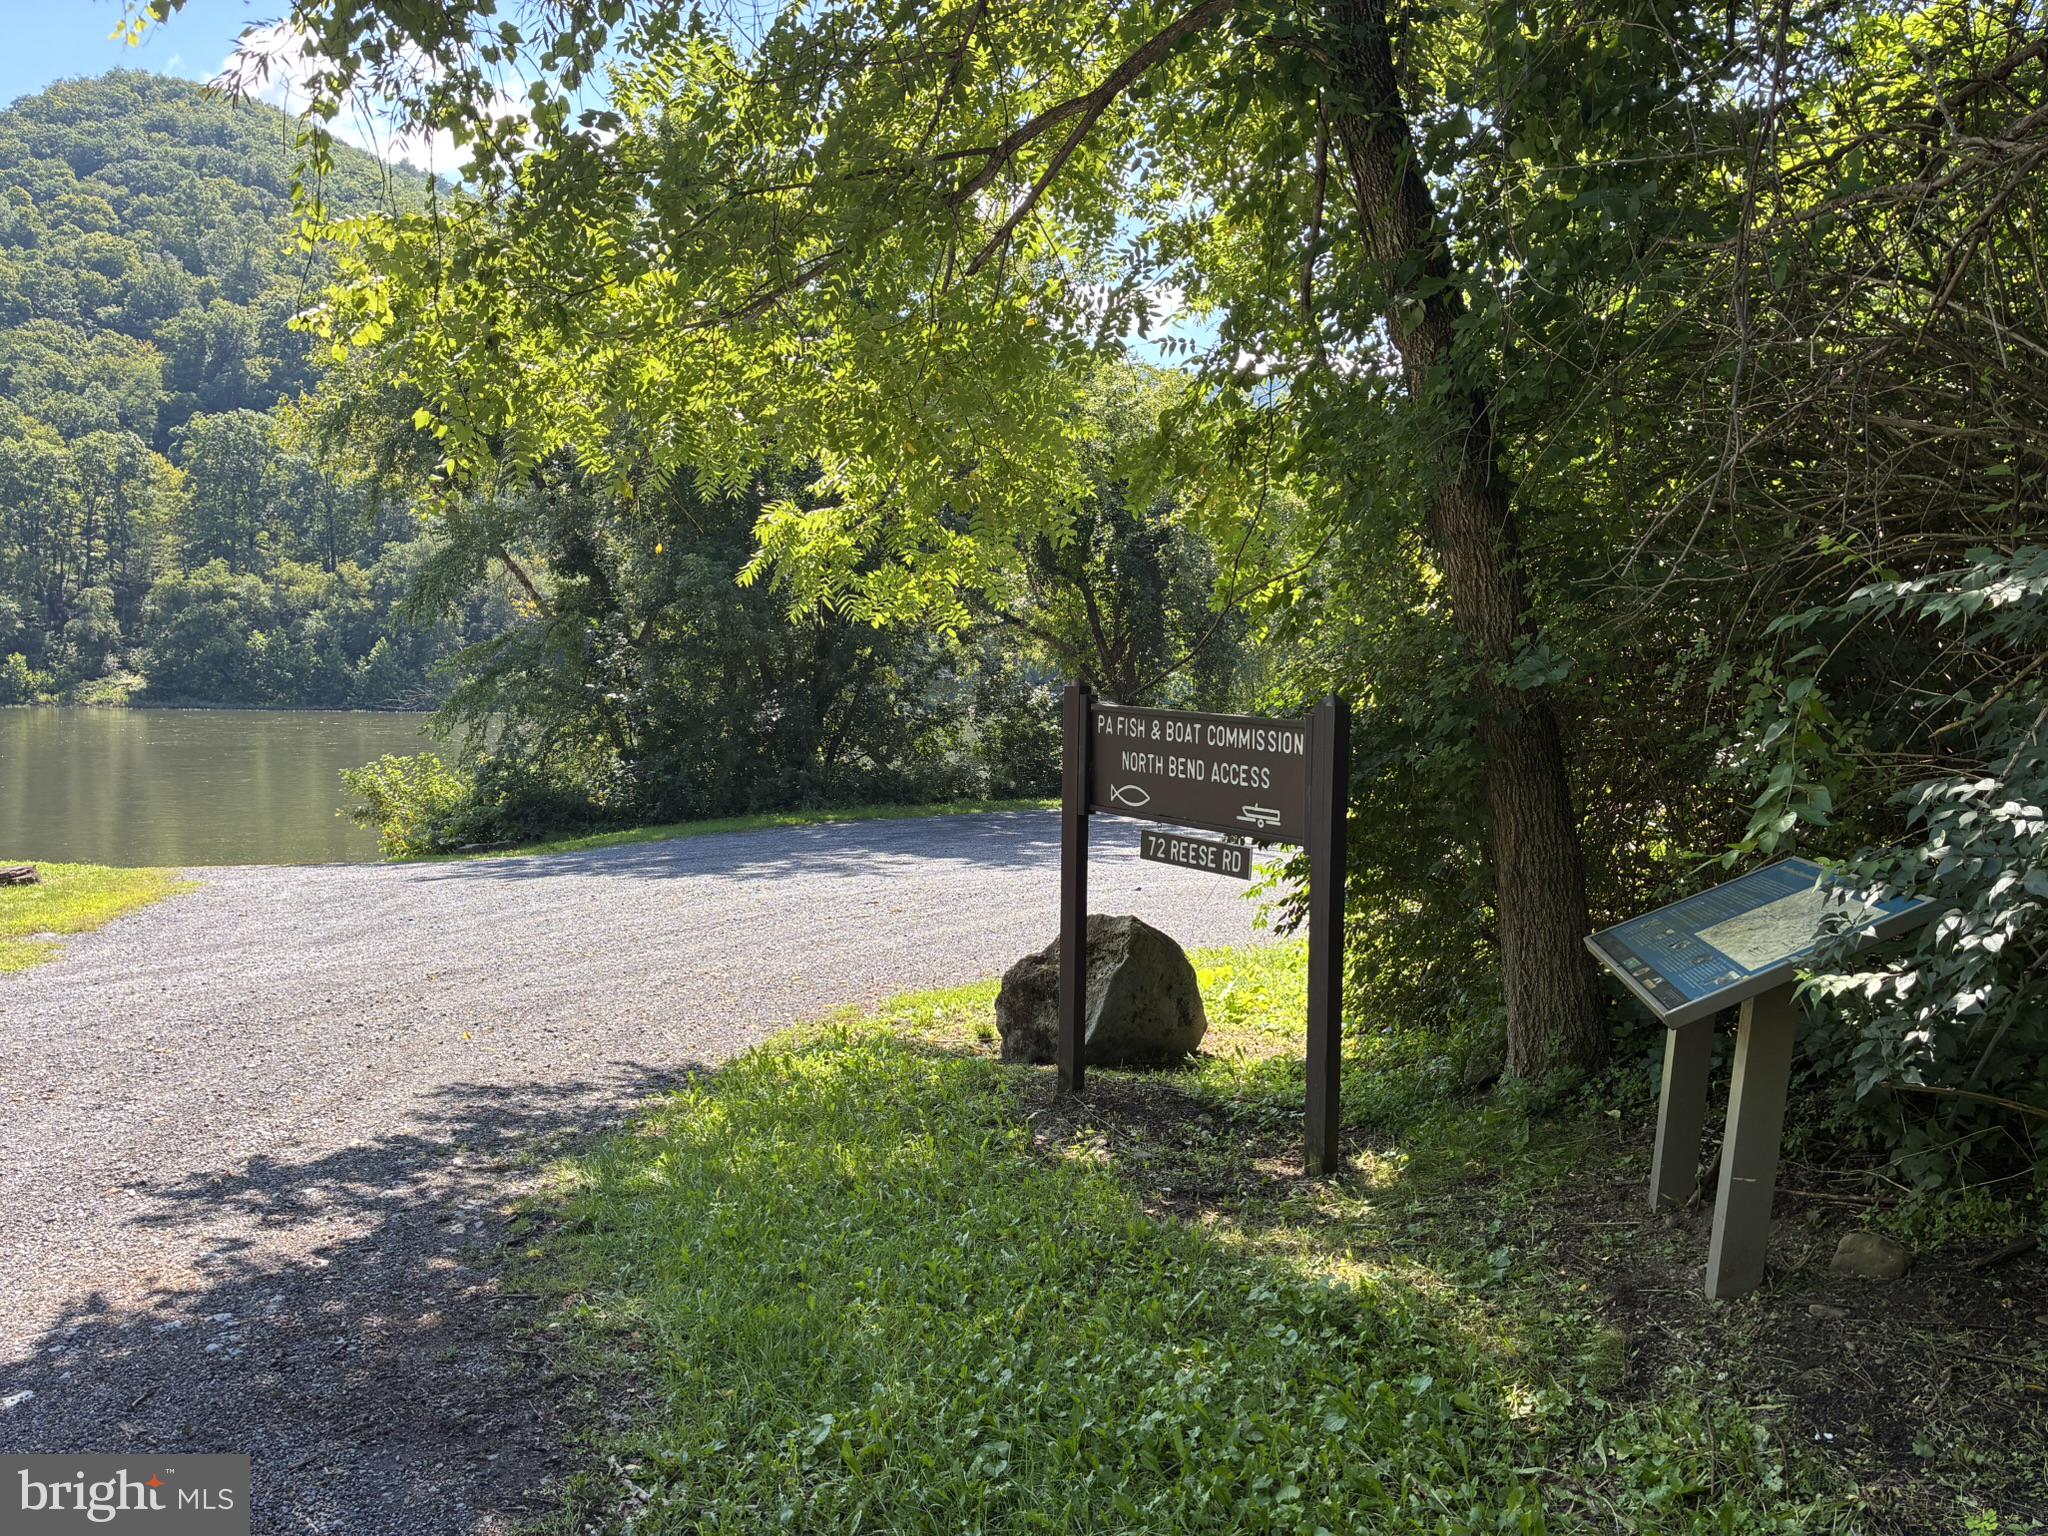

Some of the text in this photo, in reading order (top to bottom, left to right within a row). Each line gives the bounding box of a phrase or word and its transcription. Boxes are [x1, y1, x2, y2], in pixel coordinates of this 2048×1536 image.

[1097, 714, 1304, 755] PA FISH & BOAT COMMISSION
[1122, 751, 1270, 789] NORTH BEND ACCESS
[1148, 836, 1241, 872] 72 REESE RD
